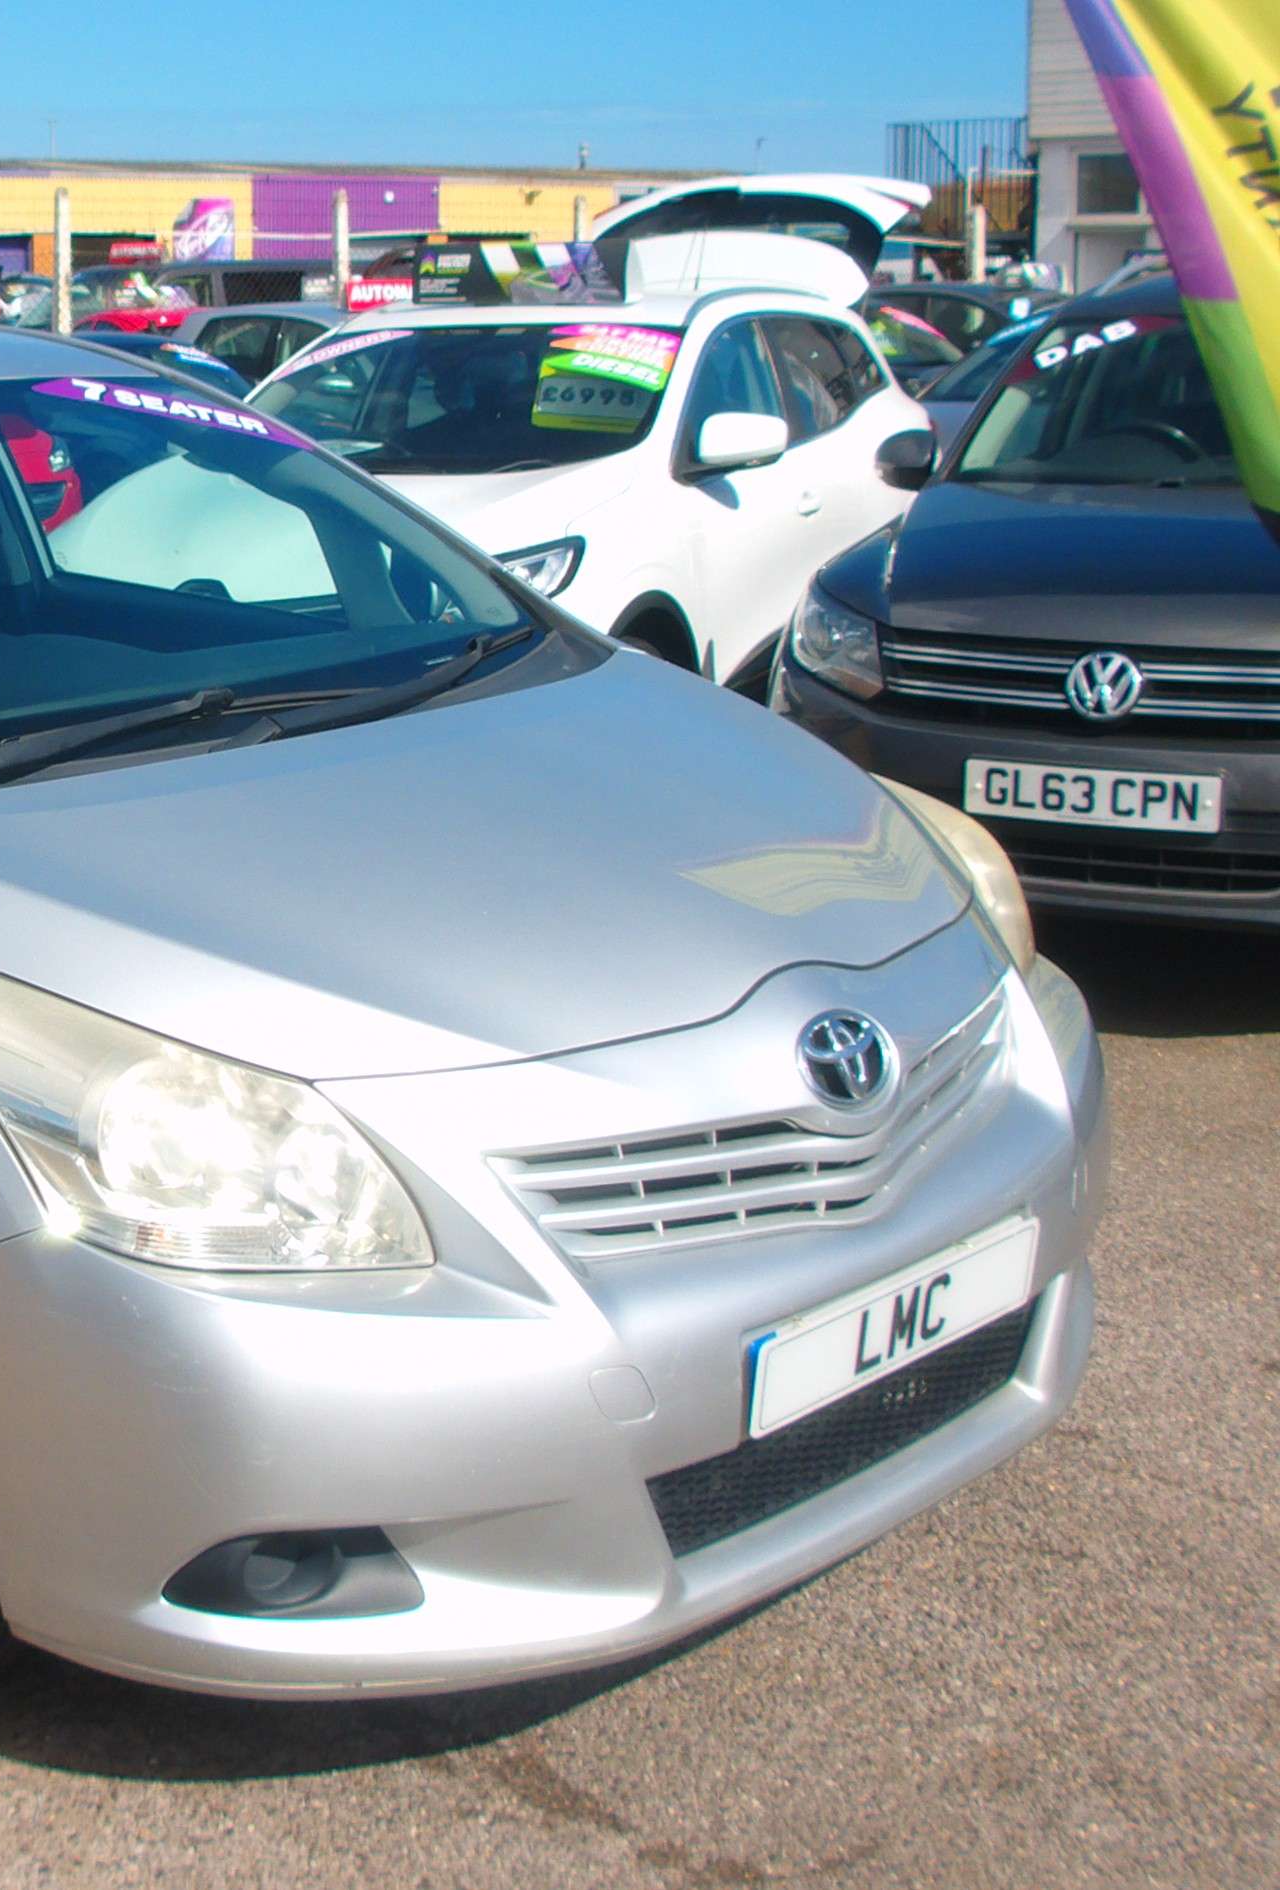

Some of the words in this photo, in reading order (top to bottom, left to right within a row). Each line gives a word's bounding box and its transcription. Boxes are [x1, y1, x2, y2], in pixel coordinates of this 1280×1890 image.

[351, 284, 413, 302] AUTOM
[571, 353, 661, 385] DIESEL
[1034, 319, 1137, 369] DAB
[72, 378, 107, 401] 7
[113, 389, 269, 435] SEATER
[984, 767, 1097, 815] GL63
[1111, 778, 1200, 822] CPN
[854, 1273, 952, 1376] LMC
